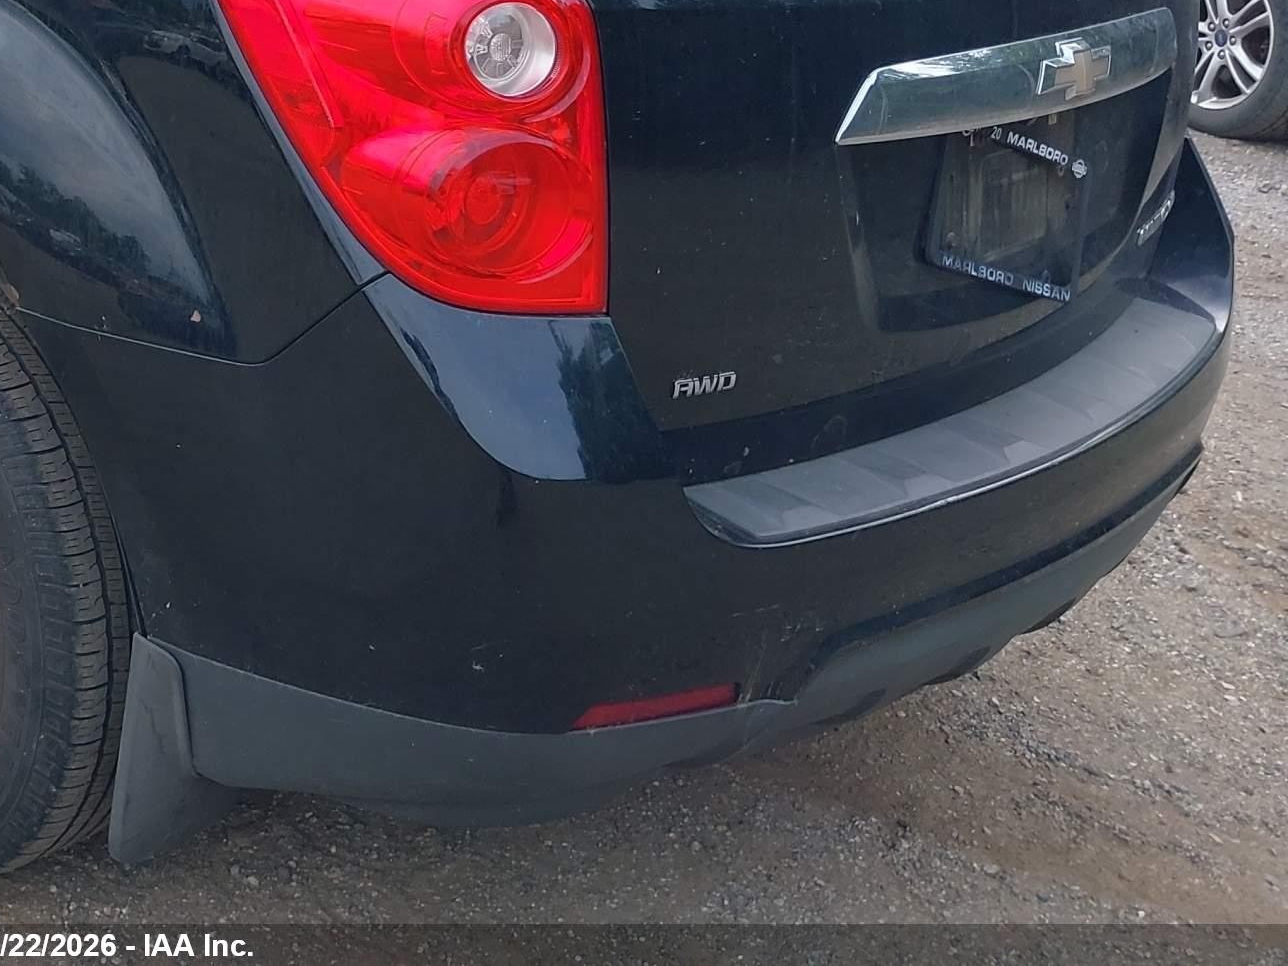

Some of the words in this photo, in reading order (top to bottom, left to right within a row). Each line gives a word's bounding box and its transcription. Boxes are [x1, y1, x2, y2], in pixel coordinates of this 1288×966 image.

[1007, 132, 1068, 165] MARLBORO
[942, 255, 1014, 285] MARLBORO
[1022, 279, 1071, 301] NISSAN
[672, 371, 737, 400] AWD
